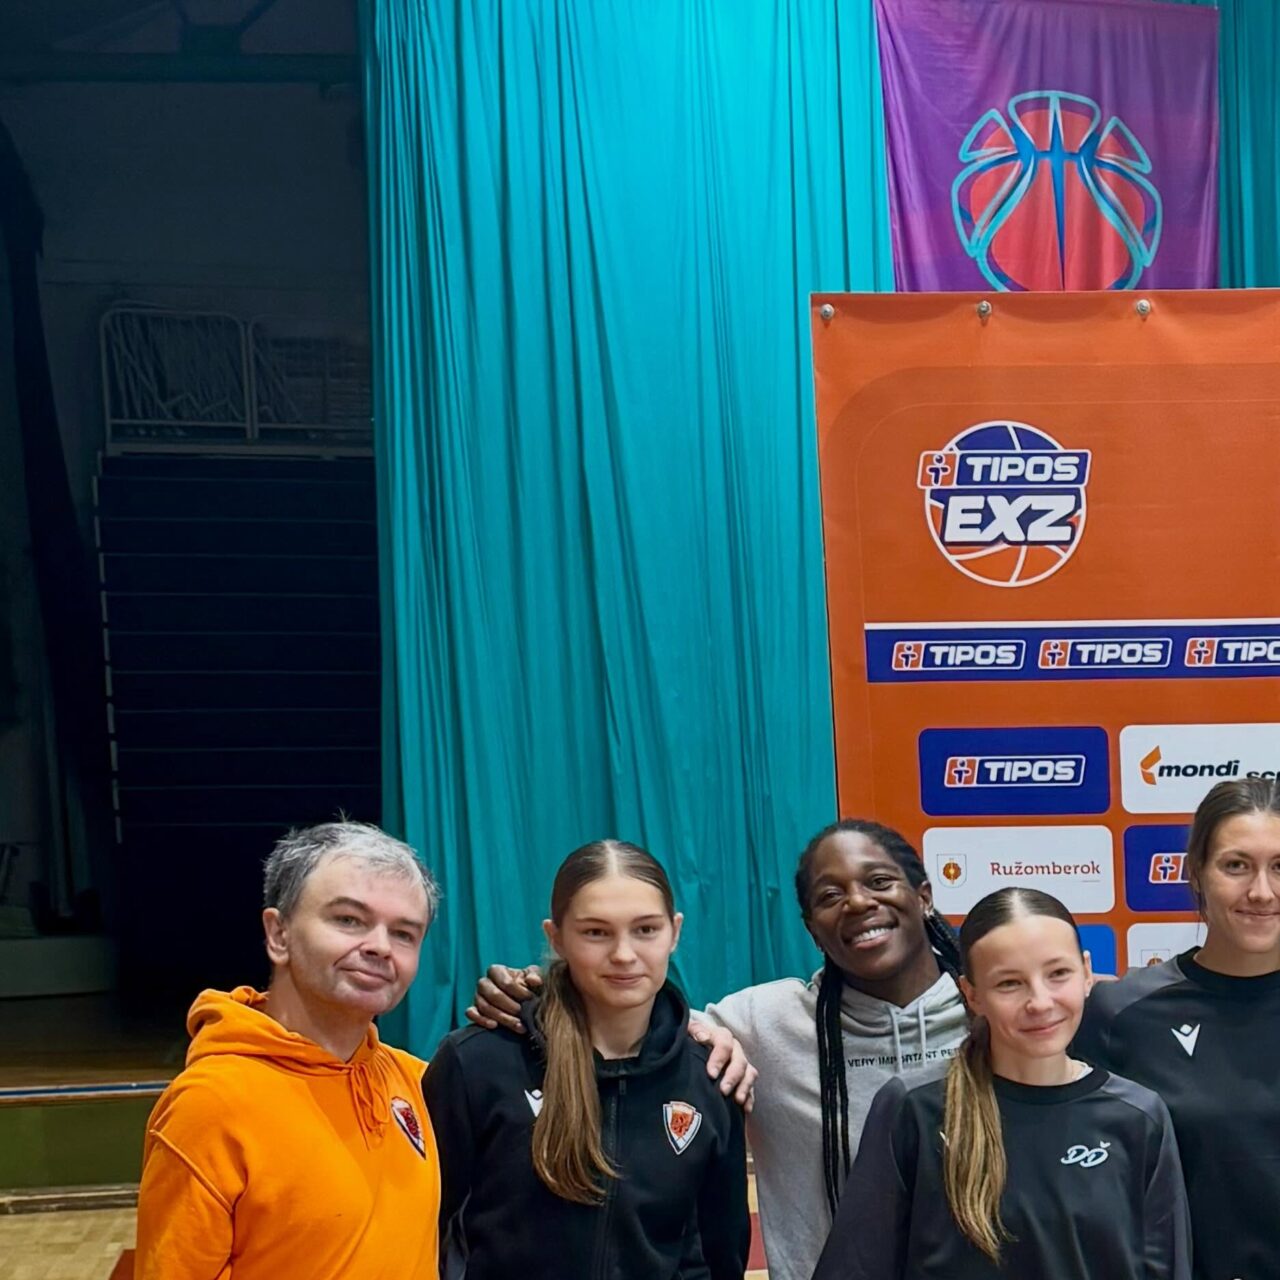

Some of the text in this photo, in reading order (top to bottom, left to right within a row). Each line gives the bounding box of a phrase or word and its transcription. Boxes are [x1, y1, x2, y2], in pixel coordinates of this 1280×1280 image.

[964, 454, 1081, 483] TIPOS
[943, 495, 1076, 543] EXZ
[929, 643, 1017, 667] TIPOS
[1075, 641, 1164, 665] TIPOS
[984, 760, 1076, 782] TIPOS
[1158, 760, 1240, 778] mondi
[990, 861, 1100, 876] Ružomberok
